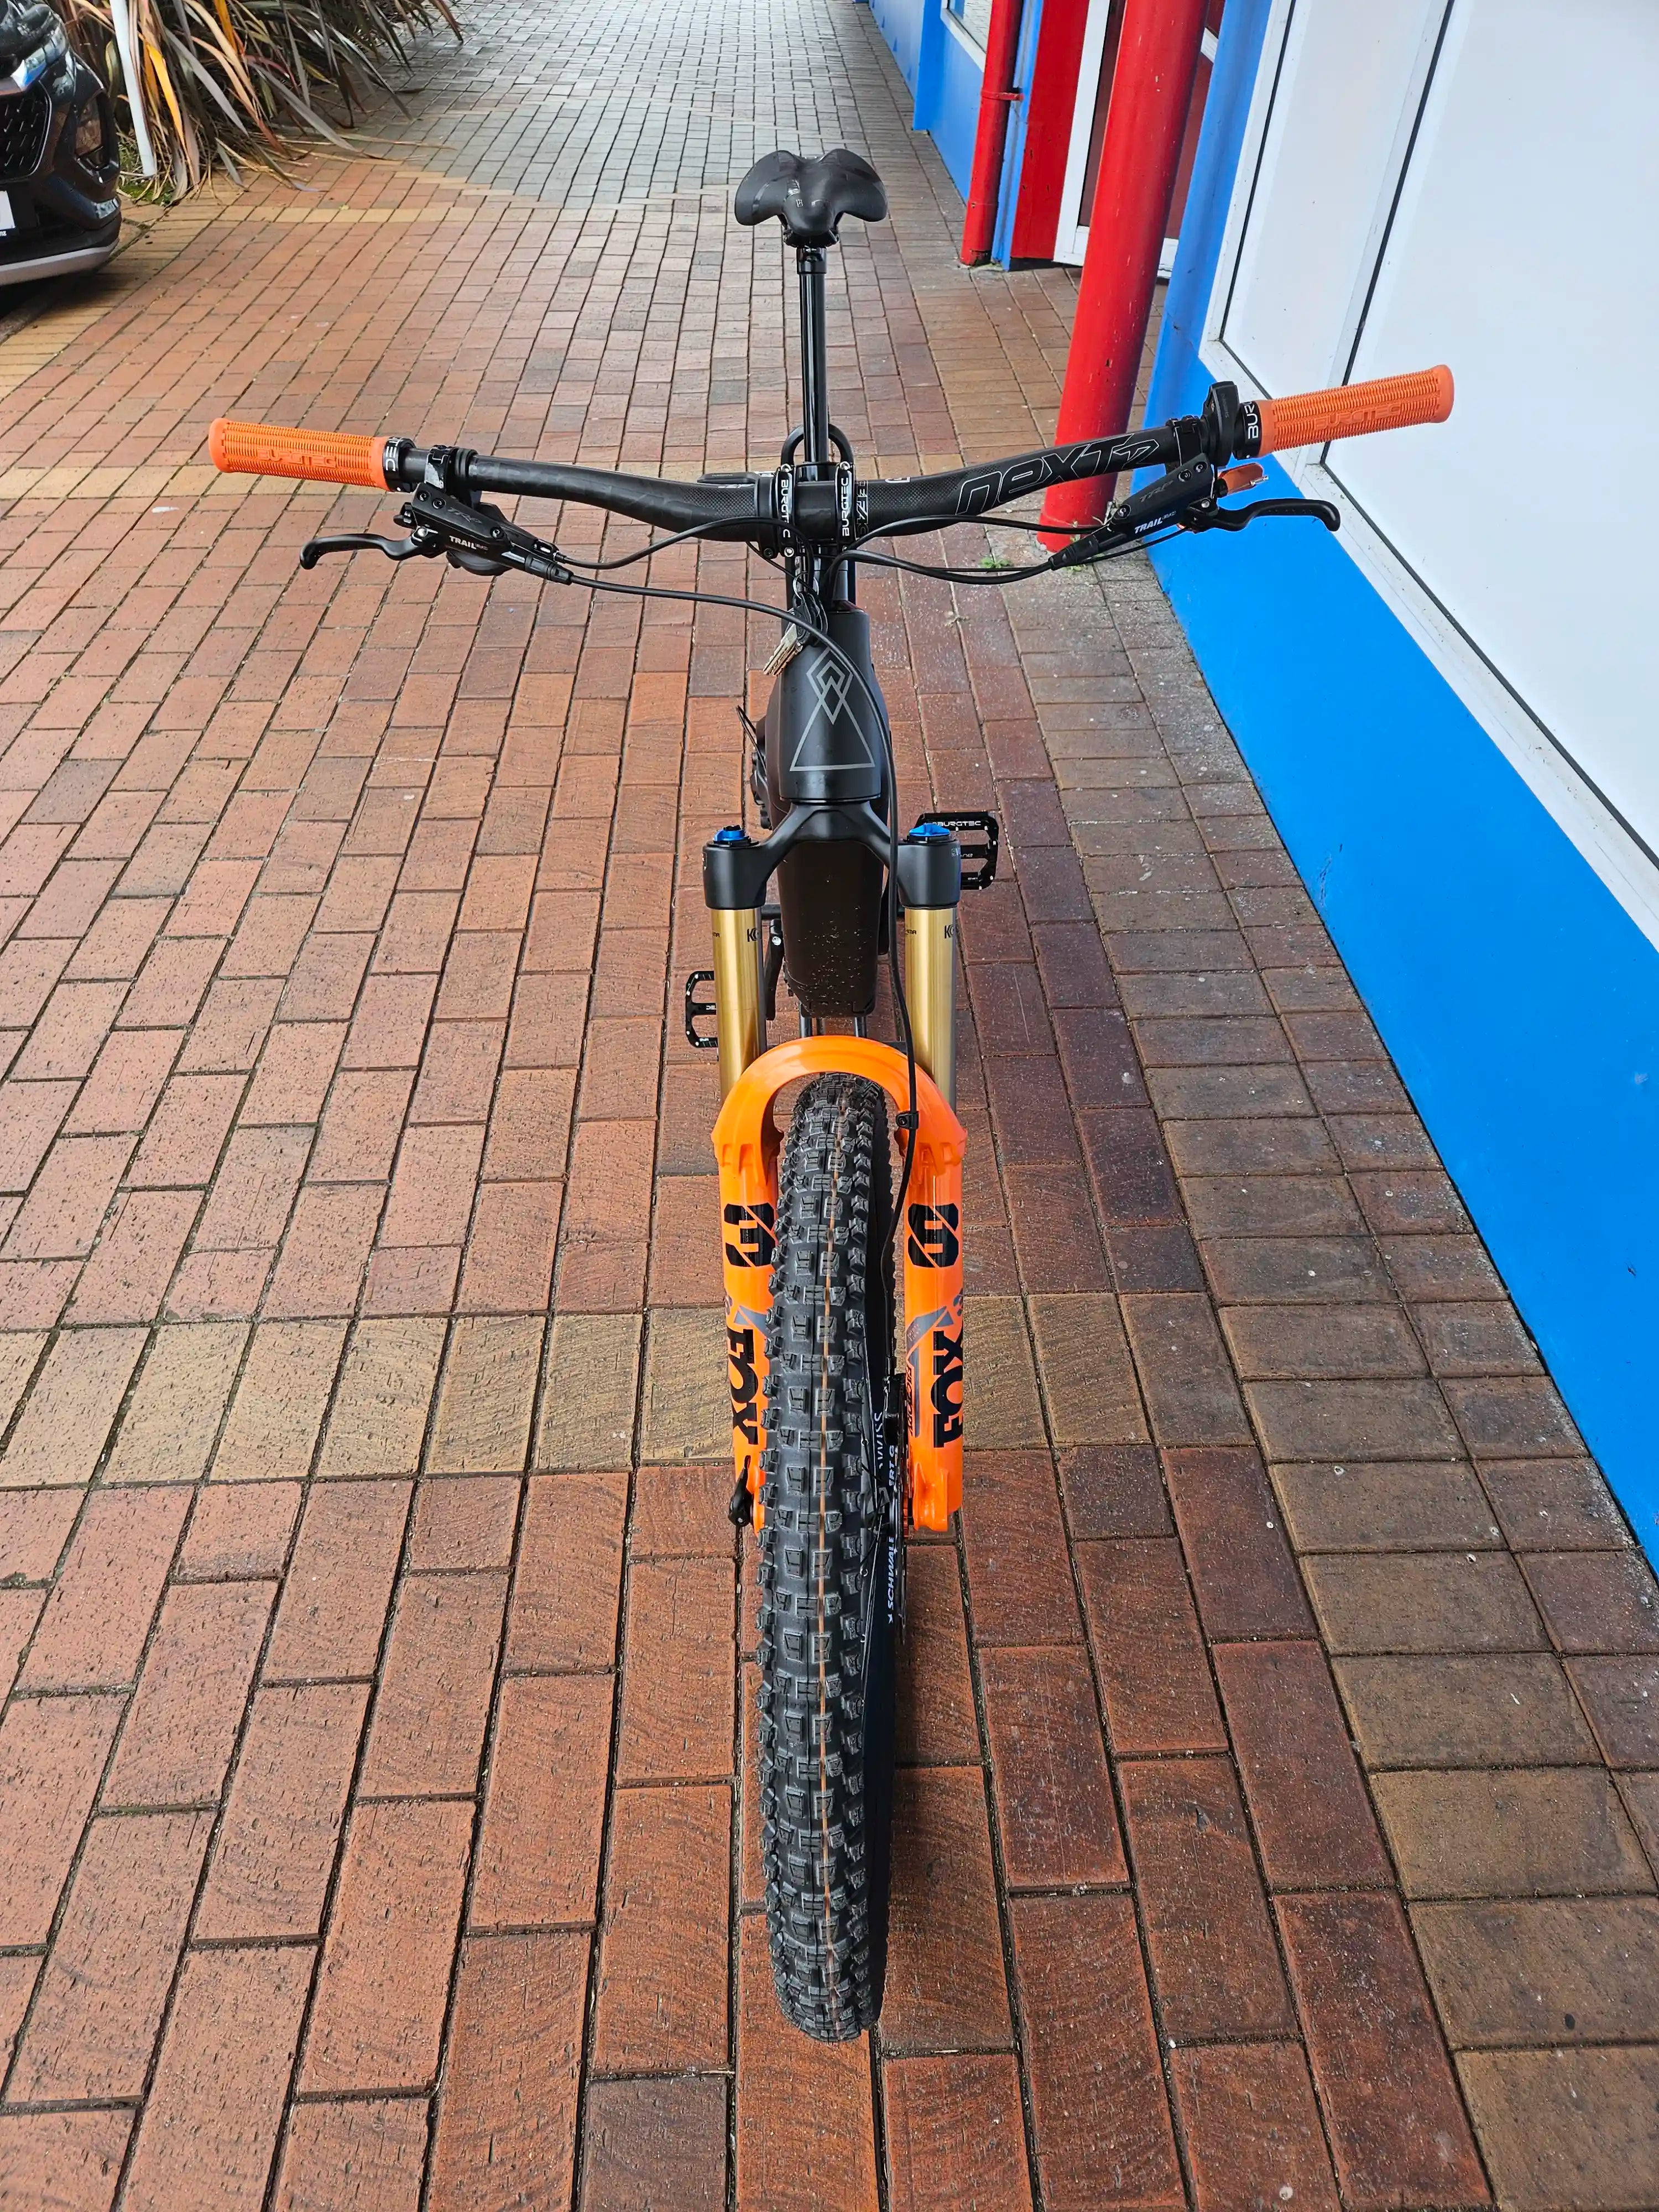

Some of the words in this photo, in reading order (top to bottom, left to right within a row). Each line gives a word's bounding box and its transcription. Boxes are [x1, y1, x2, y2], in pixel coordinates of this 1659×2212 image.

[781, 479, 791, 538] BURGTC
[841, 477, 850, 536] BURGTEC
[1134, 517, 1163, 534] TRAIL
[449, 535, 477, 550] TRAIL
[930, 1321, 963, 1448] FOX
